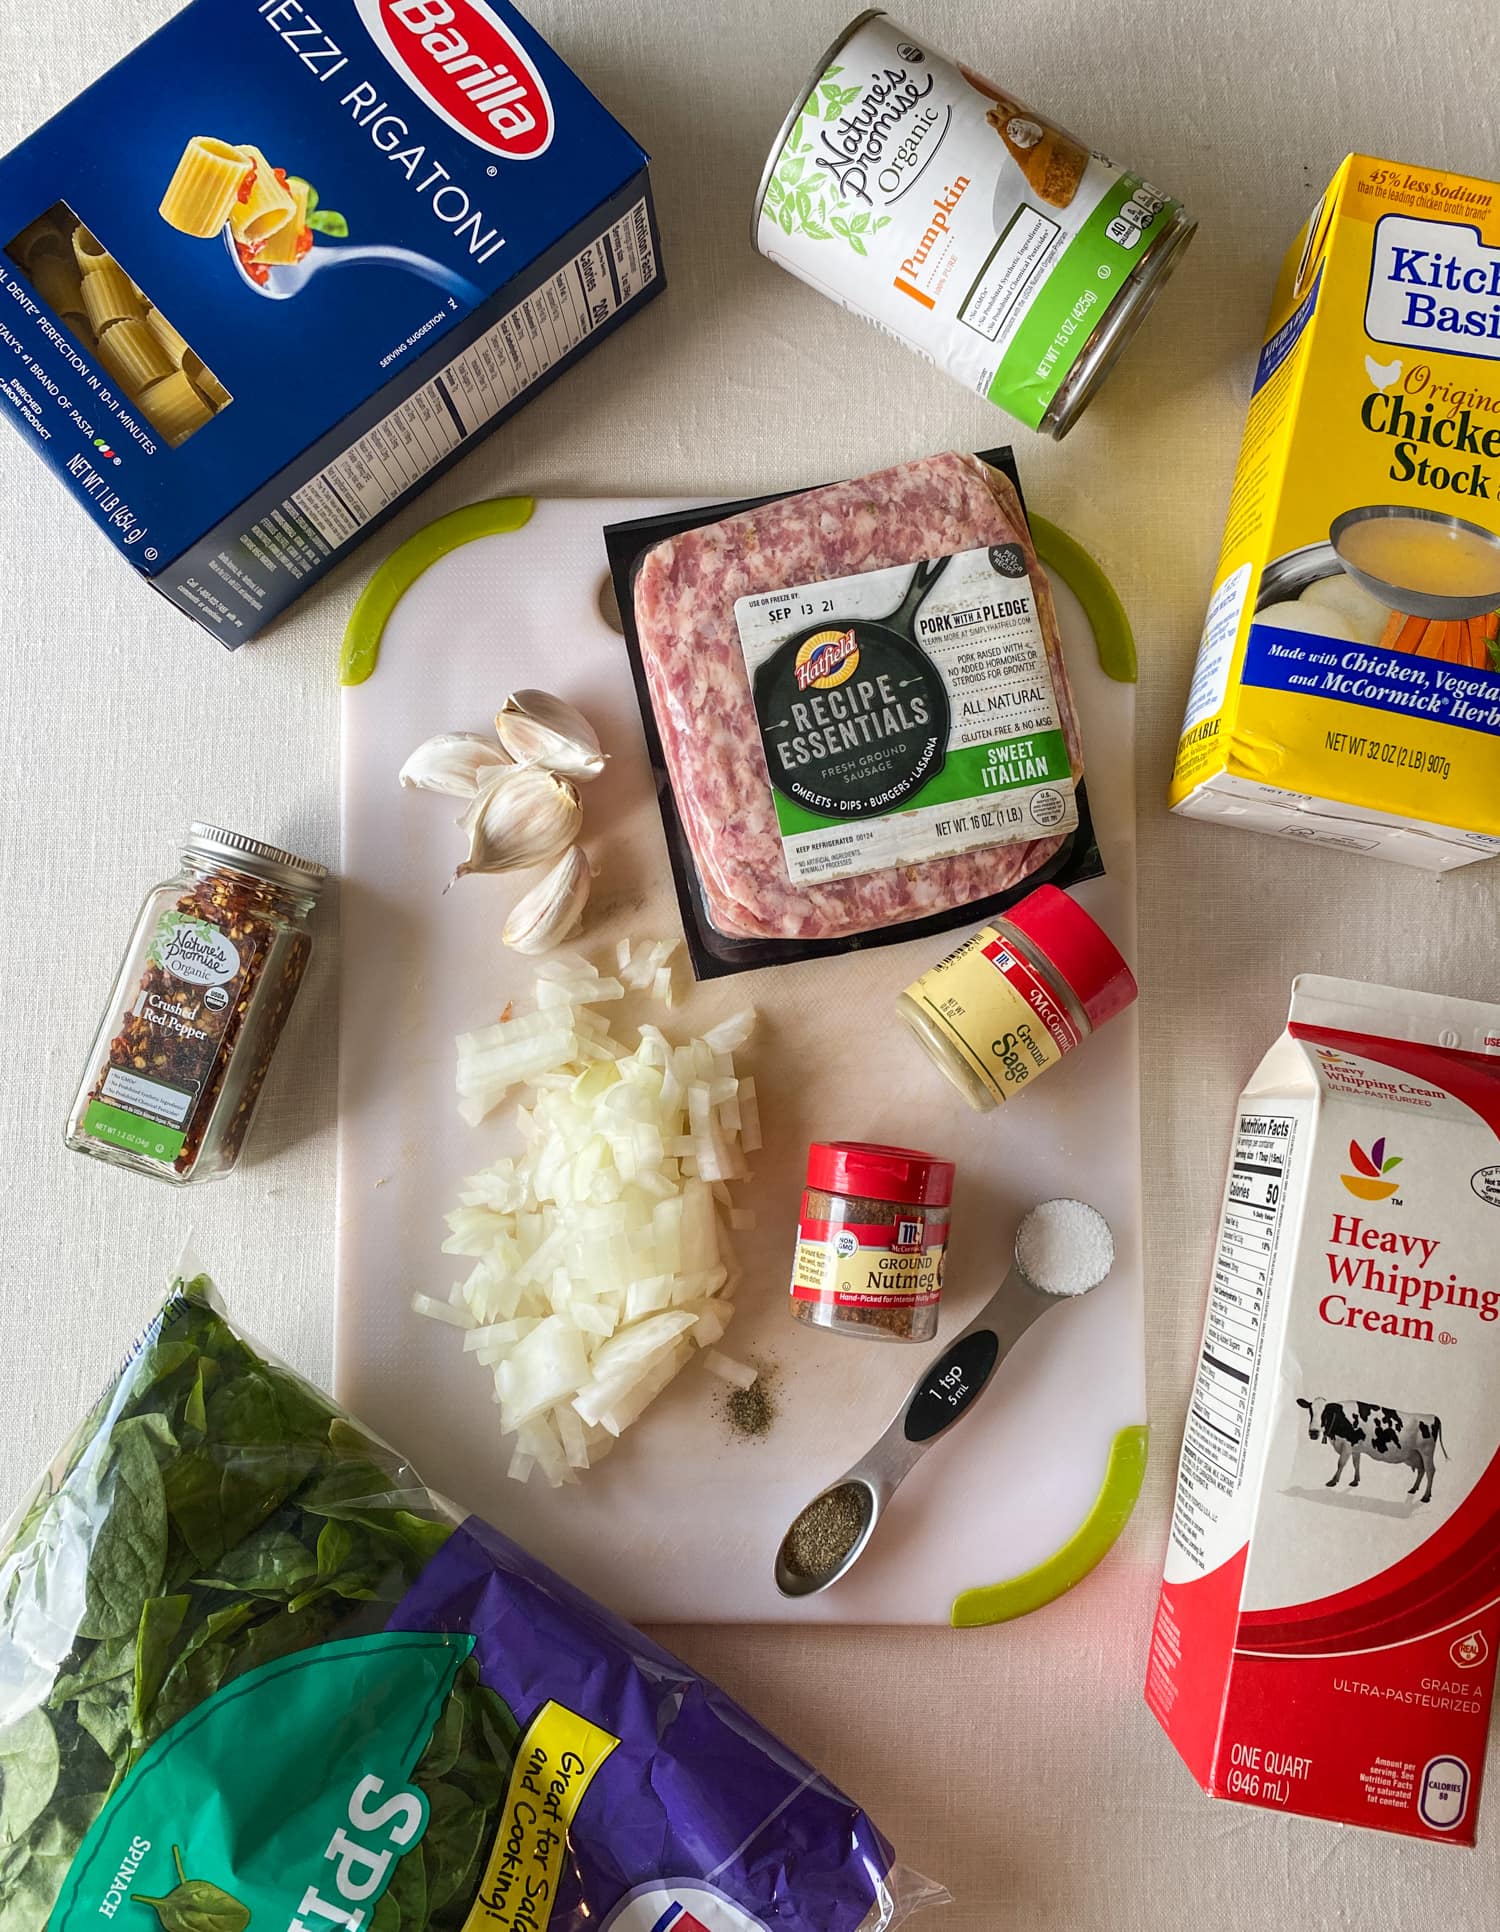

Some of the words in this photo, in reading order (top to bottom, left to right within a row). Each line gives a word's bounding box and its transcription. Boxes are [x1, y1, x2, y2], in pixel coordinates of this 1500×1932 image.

[389, 0, 536, 140] Barilla
[258, 0, 349, 82] EZZI
[340, 81, 506, 264] RIGATONI
[815, 69, 907, 181] Nature's
[838, 73, 934, 207] Promise
[878, 107, 939, 193] Organic
[1357, 181, 1374, 195] than
[1374, 184, 1387, 198] the
[1388, 186, 1415, 207] leading
[1416, 192, 1443, 211] chicken
[1444, 197, 1464, 215] broth
[1369, 168, 1401, 188] 45%
[1403, 174, 1431, 193] less
[1432, 182, 1493, 207] Sodium
[632, 204, 650, 254] Nutrition
[900, 175, 971, 280] Pumpkin
[1109, 221, 1126, 238] 40
[579, 249, 598, 292] Calories
[640, 253, 652, 282] Facts
[999, 254, 1021, 285] Synthetic
[1008, 259, 1030, 291] Chemical
[1069, 287, 1099, 323] (425g)
[379, 343, 407, 368] SERVING
[407, 311, 446, 345] SUGGESTION
[1053, 332, 1069, 348] 15
[1060, 318, 1078, 335] OZ
[1034, 359, 1053, 379] NET
[1043, 345, 1062, 364] WT
[10, 378, 43, 415] ENRICHED
[29, 363, 60, 397] BRAND
[57, 395, 73, 410] OF
[69, 409, 96, 439] PASTA
[36, 316, 90, 377] PERFECTION
[87, 375, 102, 390] IN
[98, 388, 120, 412] 10-11
[116, 410, 157, 455] MINUTES
[20, 403, 52, 440] PRODUCT
[1361, 392, 1500, 458] Chicke
[66, 452, 92, 479] NET
[82, 468, 105, 495] WT.
[1390, 441, 1491, 499] Stock
[95, 486, 110, 501] 1
[100, 492, 120, 512] LB
[108, 505, 137, 532] (454
[749, 600, 760, 608] USE
[769, 594, 790, 604] FREEZE
[768, 607, 792, 622] SEP
[800, 603, 814, 616] 13
[822, 600, 834, 612] 21
[920, 614, 952, 635] PORK
[953, 613, 974, 626] WITH
[794, 628, 858, 692] Hatfield
[948, 667, 960, 677] NO
[961, 662, 985, 674] ADDED
[986, 654, 1026, 669] HORMONES
[1027, 650, 1038, 659] OR
[957, 652, 976, 664] PORK
[977, 647, 1002, 660] RAISED
[1003, 643, 1024, 654] WITH
[951, 674, 986, 687] STEROIDS
[987, 669, 1002, 679] FOR
[1267, 644, 1306, 661] Made
[1308, 648, 1338, 667] with
[1341, 652, 1430, 689] Chicken,
[1435, 670, 1500, 700] Vegeta
[791, 674, 896, 733] RECIPE
[962, 701, 985, 717] ALL
[1288, 671, 1318, 688] and
[1320, 673, 1443, 713] McCormick
[1448, 699, 1500, 728] Herb
[776, 697, 930, 771] ESSENTIALS
[961, 730, 993, 744] GLUTEN
[994, 725, 1013, 736] FREE
[1022, 719, 1034, 730] NO
[1035, 716, 1053, 727] MSG
[821, 760, 856, 779] FRESH
[858, 744, 907, 767] GROUND
[987, 741, 1033, 765] SWEET
[1325, 731, 1348, 752] NET
[1349, 735, 1367, 755] WT
[1367, 741, 1381, 760] 32
[1382, 744, 1397, 764] OZ
[1427, 753, 1451, 780] 907g
[791, 782, 832, 810] OMELETS
[840, 798, 862, 811] DIPS
[869, 779, 910, 808] BURGERS
[911, 736, 938, 779] LASAGNA
[844, 762, 893, 784] SAUSAGE
[981, 756, 1049, 789] ITALIAN
[935, 821, 951, 837] NET
[952, 818, 969, 834] WT.
[970, 815, 981, 830] 16
[982, 813, 995, 828] OZ.
[796, 845, 810, 854] KEEP
[811, 836, 853, 850] REFRIGERATED
[176, 929, 227, 962] Nature's
[171, 960, 210, 980] Organic
[149, 995, 197, 1021] Crushed
[144, 1008, 166, 1026] Red
[167, 1017, 208, 1042] Pepper
[991, 1032, 1029, 1083] Sage
[1016, 1024, 1048, 1067] Ground
[1321, 1062, 1365, 1077] Heavy
[1324, 1071, 1398, 1093] Whipping
[1399, 1083, 1447, 1100] Cream
[1328, 1083, 1432, 1107] ULTRA-PASTEURIZED
[1240, 1118, 1267, 1134] Nutrition
[1267, 1119, 1289, 1137] Facts
[1266, 1184, 1279, 1204] 50
[1329, 1213, 1440, 1269] Heavy
[879, 1257, 933, 1270] GROUND
[866, 1271, 935, 1291] Nutmeg
[1325, 1252, 1500, 1321] Whipping
[839, 1293, 882, 1303] Hand-Picked
[1319, 1294, 1434, 1342] Cream
[929, 1388, 942, 1400] 1
[938, 1366, 963, 1390] tsp
[948, 1394, 958, 1406] 5
[1333, 1678, 1481, 1714] ULTRA-PASTEURIZED
[1421, 1678, 1469, 1695] GRADE
[1473, 1685, 1483, 1697] A
[519, 1748, 548, 1796] and
[1231, 1743, 1261, 1770] ONE
[1264, 1751, 1312, 1780] QUART
[1375, 1757, 1402, 1769] Amount
[1403, 1763, 1416, 1771] per
[1401, 1771, 1414, 1780] See
[546, 1751, 585, 1828] Great
[1227, 1770, 1259, 1796] (946
[1262, 1779, 1290, 1805] mL)
[1360, 1773, 1391, 1786] Nutrition
[1393, 1779, 1413, 1790] Facts
[1377, 1787, 1412, 1799] saturated
[1429, 1780, 1461, 1793] CALORIES
[287, 1773, 423, 1932] SPI
[479, 1801, 537, 1924] Cooking!
[535, 1827, 560, 1871] for
[98, 1835, 152, 1920] SPINACH
